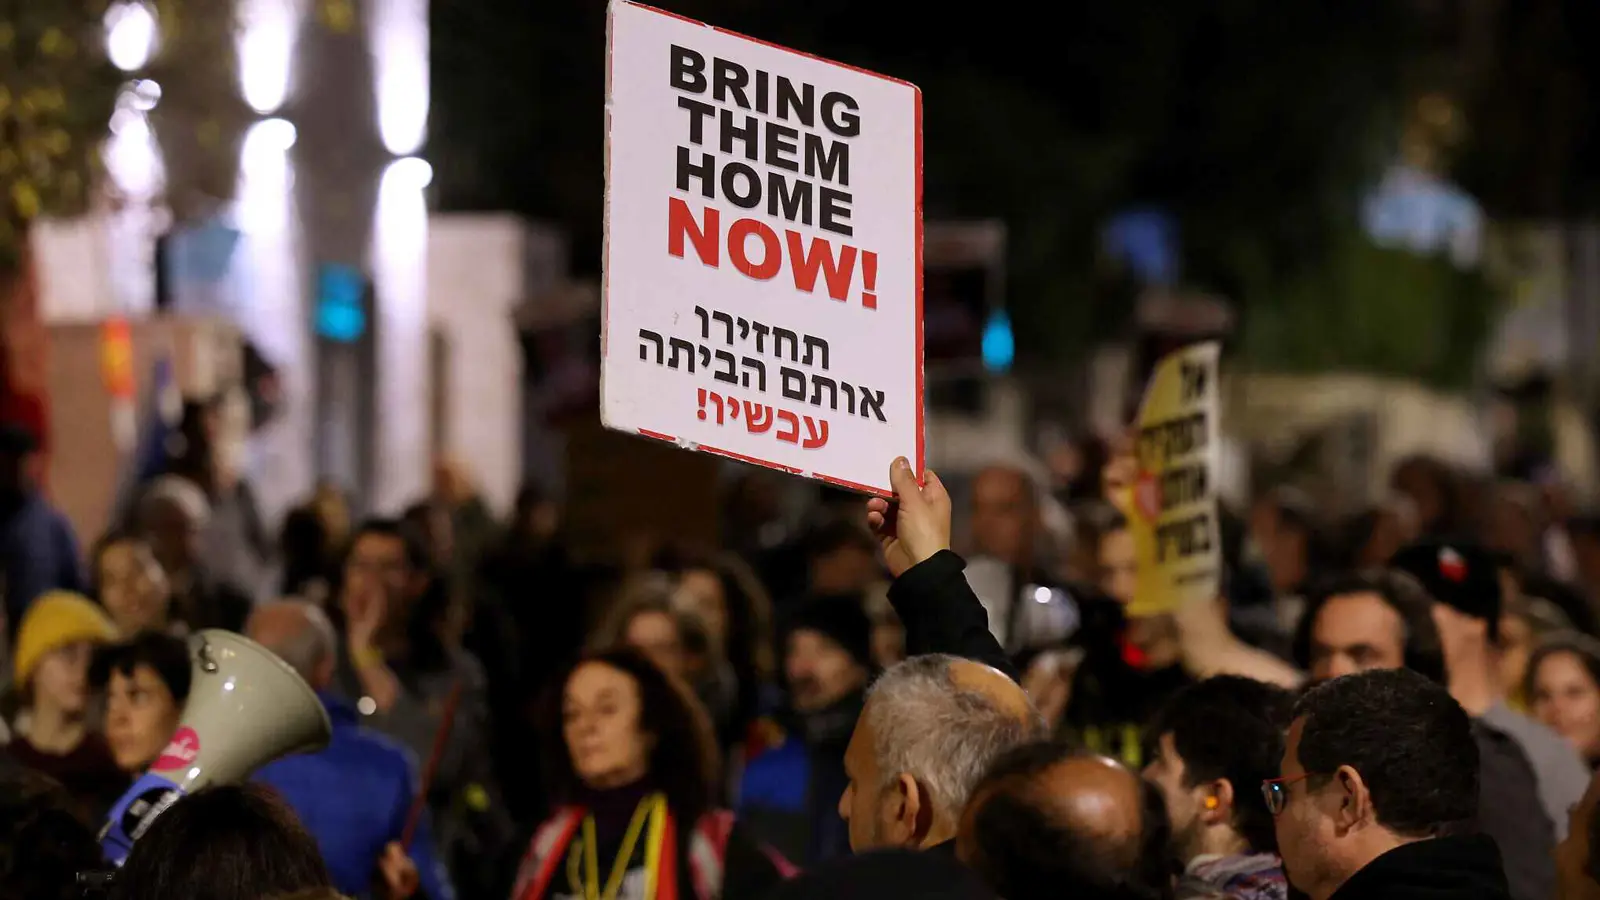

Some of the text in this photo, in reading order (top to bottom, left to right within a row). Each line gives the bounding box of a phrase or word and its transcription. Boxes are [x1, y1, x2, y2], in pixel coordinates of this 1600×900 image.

[670, 44, 861, 138] BRING
[678, 96, 850, 187] THEM
[676, 146, 854, 237] HOME
[668, 197, 878, 311] NOW!
[639, 329, 888, 423] אותם הביתה
[695, 305, 830, 371] תחזירו
[697, 388, 829, 449] עכשיו!
